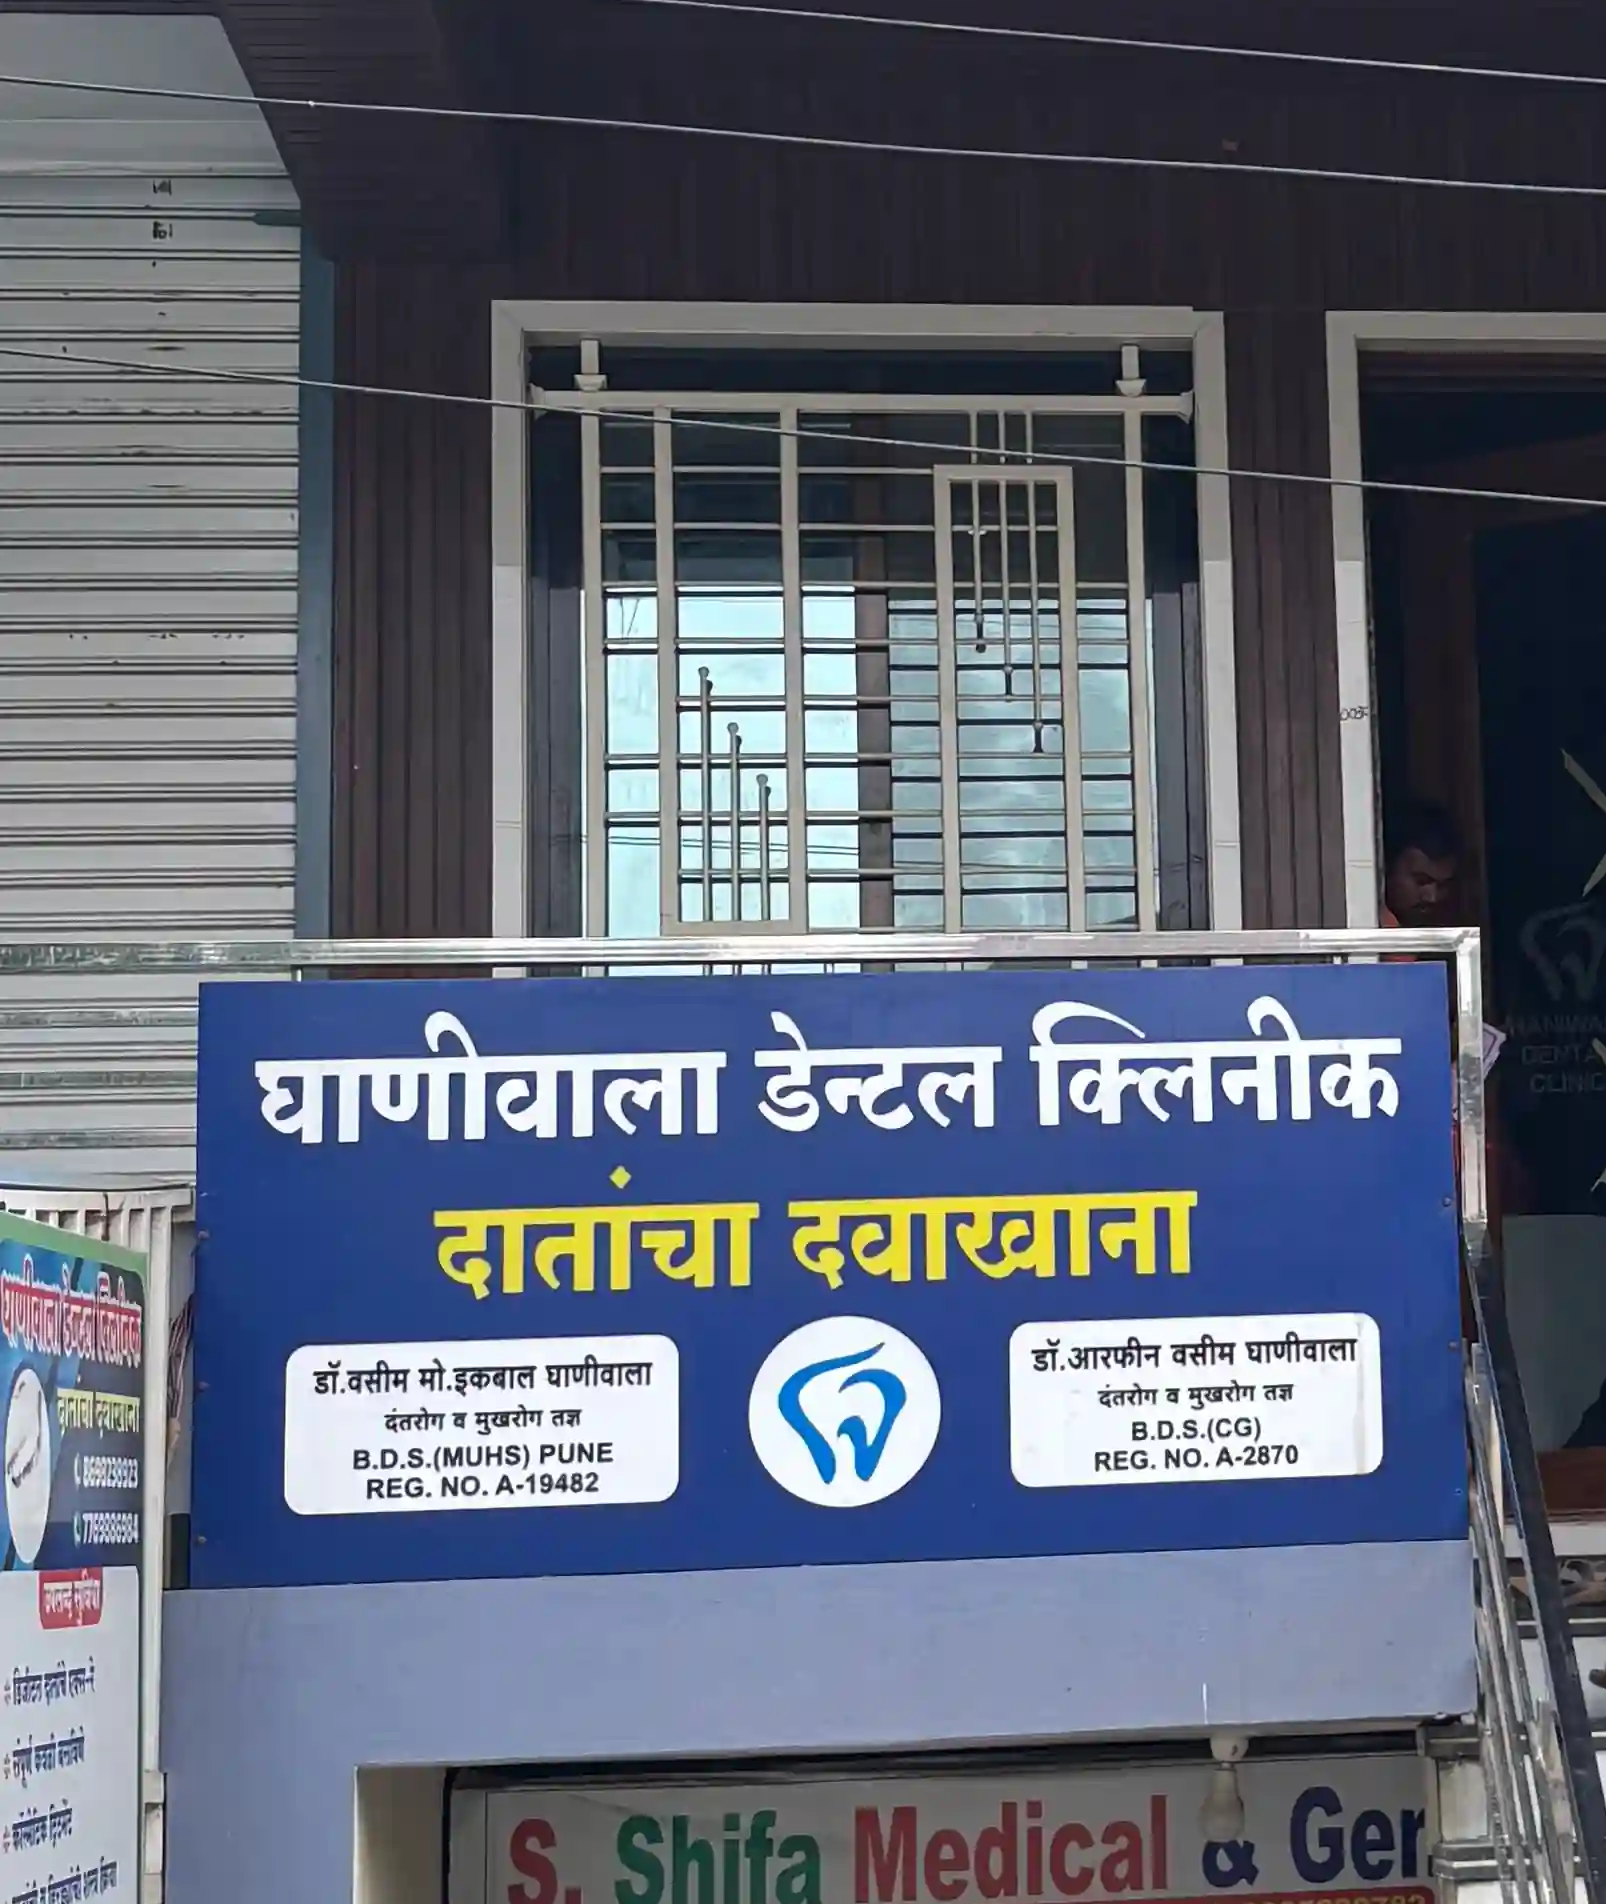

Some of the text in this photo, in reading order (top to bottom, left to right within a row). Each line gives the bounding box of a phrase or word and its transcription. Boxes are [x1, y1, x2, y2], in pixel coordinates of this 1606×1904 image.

[254, 996, 1401, 1145] घाणीवाला डेन्टल क्लिनीक
[434, 1165, 1198, 1301] दातांचा दवाखाना
[1032, 1331, 1357, 1372] डॉ.आरफीन वसीम घाणीवाला
[313, 1359, 410, 1395] डॉ.वसीम
[546, 1354, 653, 1388] घाणीवाला
[1098, 1380, 1293, 1410] दंतरोग व मुखरोग तज्ञ
[384, 1404, 582, 1435] दंतरोग व मुखरोग तज्ञ
[1131, 1417, 1261, 1443] B.D.S.(CG)
[352, 1442, 614, 1472] B.D.S.(MUHS) PUNE
[1094, 1445, 1299, 1472] REG. NO. A-2870
[366, 1472, 599, 1500] REG. NO. A-19482
[854, 1795, 1168, 1904] Medical
